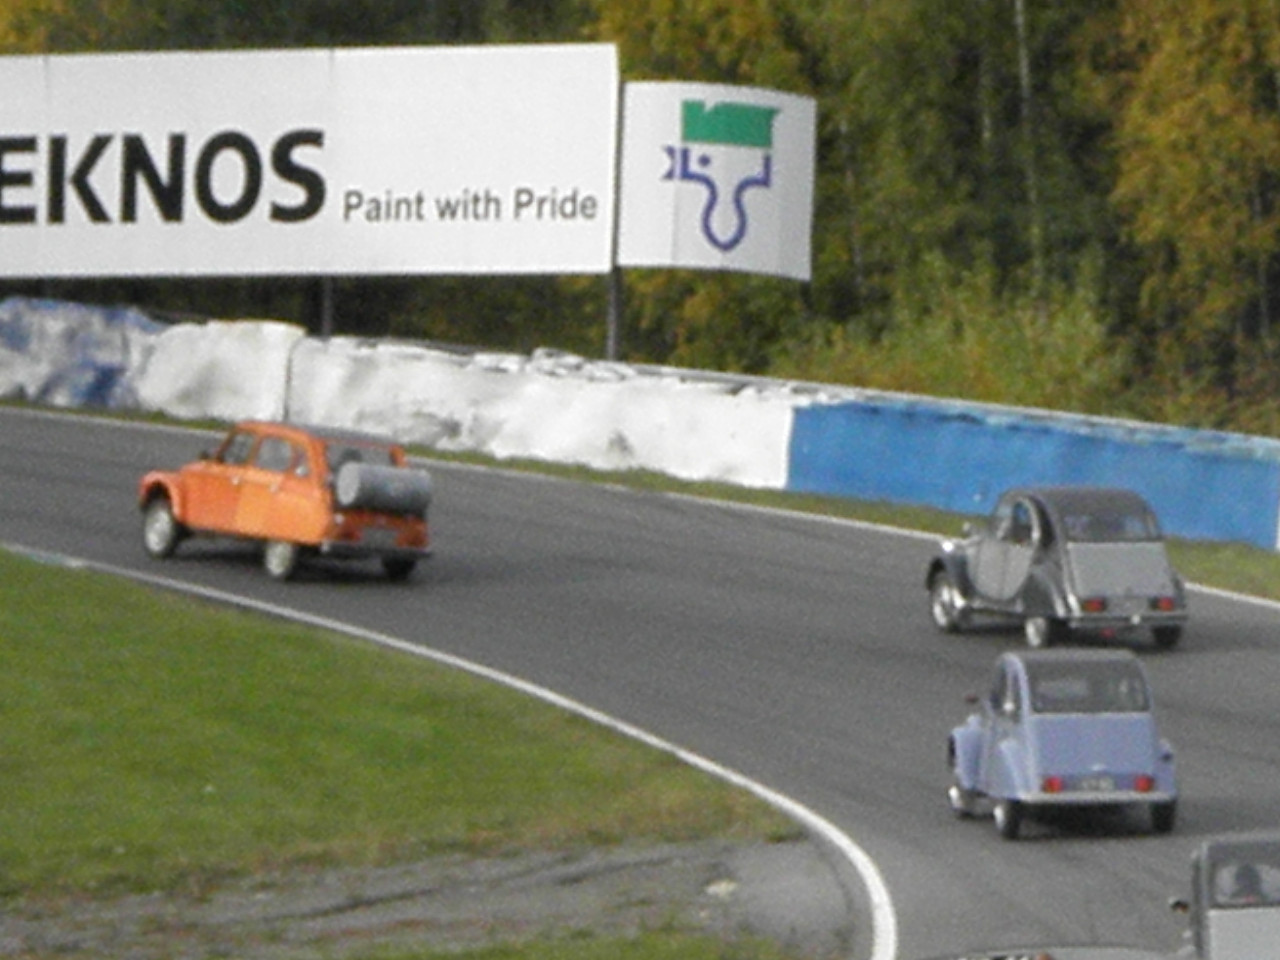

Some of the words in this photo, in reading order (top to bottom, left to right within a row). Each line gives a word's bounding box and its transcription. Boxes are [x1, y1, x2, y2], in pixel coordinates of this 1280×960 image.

[344, 189, 425, 222] Paint
[436, 187, 501, 220] with
[514, 187, 598, 220] Pride
